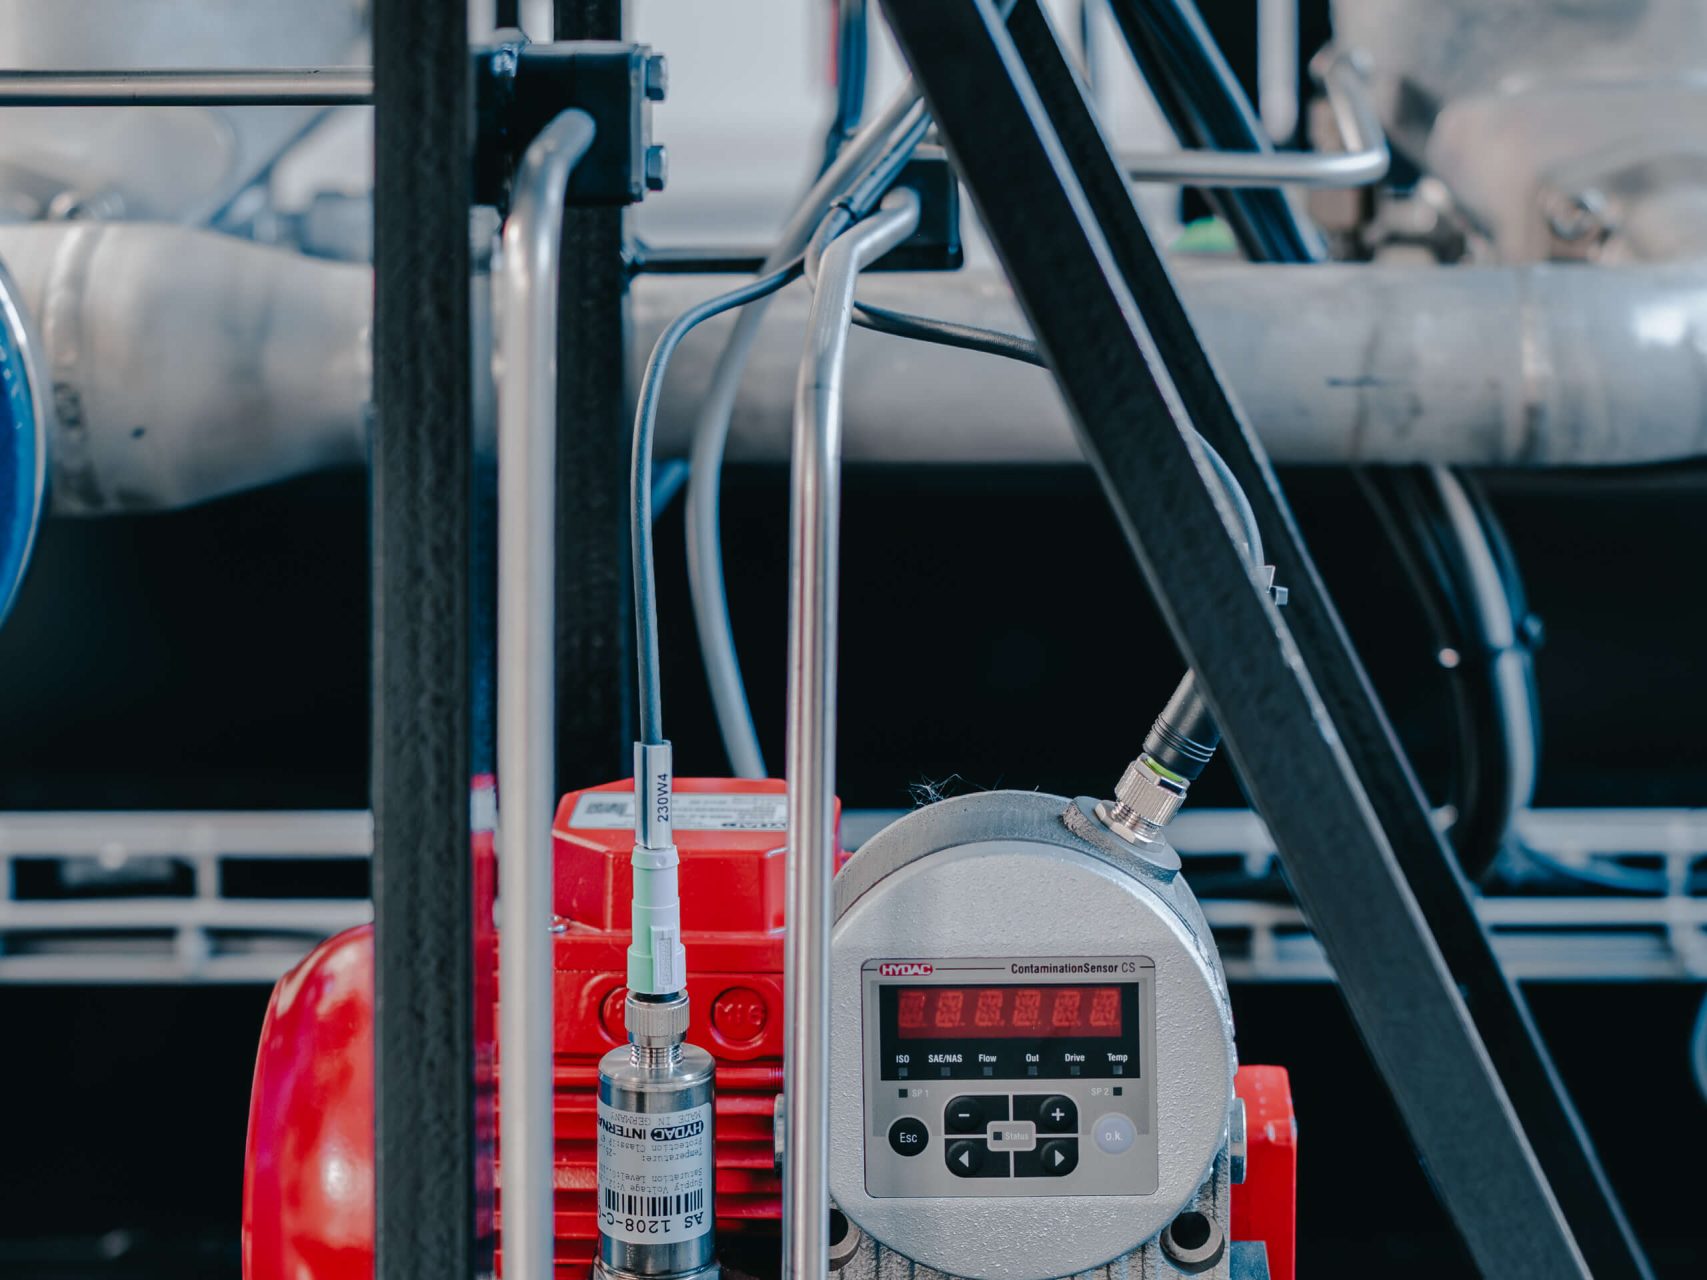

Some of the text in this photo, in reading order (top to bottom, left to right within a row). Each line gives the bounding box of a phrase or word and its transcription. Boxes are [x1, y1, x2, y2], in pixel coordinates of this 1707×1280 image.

[657, 773, 669, 823] 230W4
[880, 963, 932, 976] HYDAC
[1011, 962, 1136, 974] ContaminationSensor CS
[896, 1055, 910, 1064] ISO
[928, 1054, 963, 1063] SAE/NAS
[978, 1054, 997, 1063] Flow
[1026, 1053, 1040, 1062] Out
[1065, 1053, 1086, 1062] Drive
[1108, 1053, 1129, 1063] Temp
[652, 1121, 702, 1140] HYDAC
[899, 1132, 918, 1143] Esc
[1005, 1131, 1029, 1141] Status
[684, 1212, 704, 1228] AS
